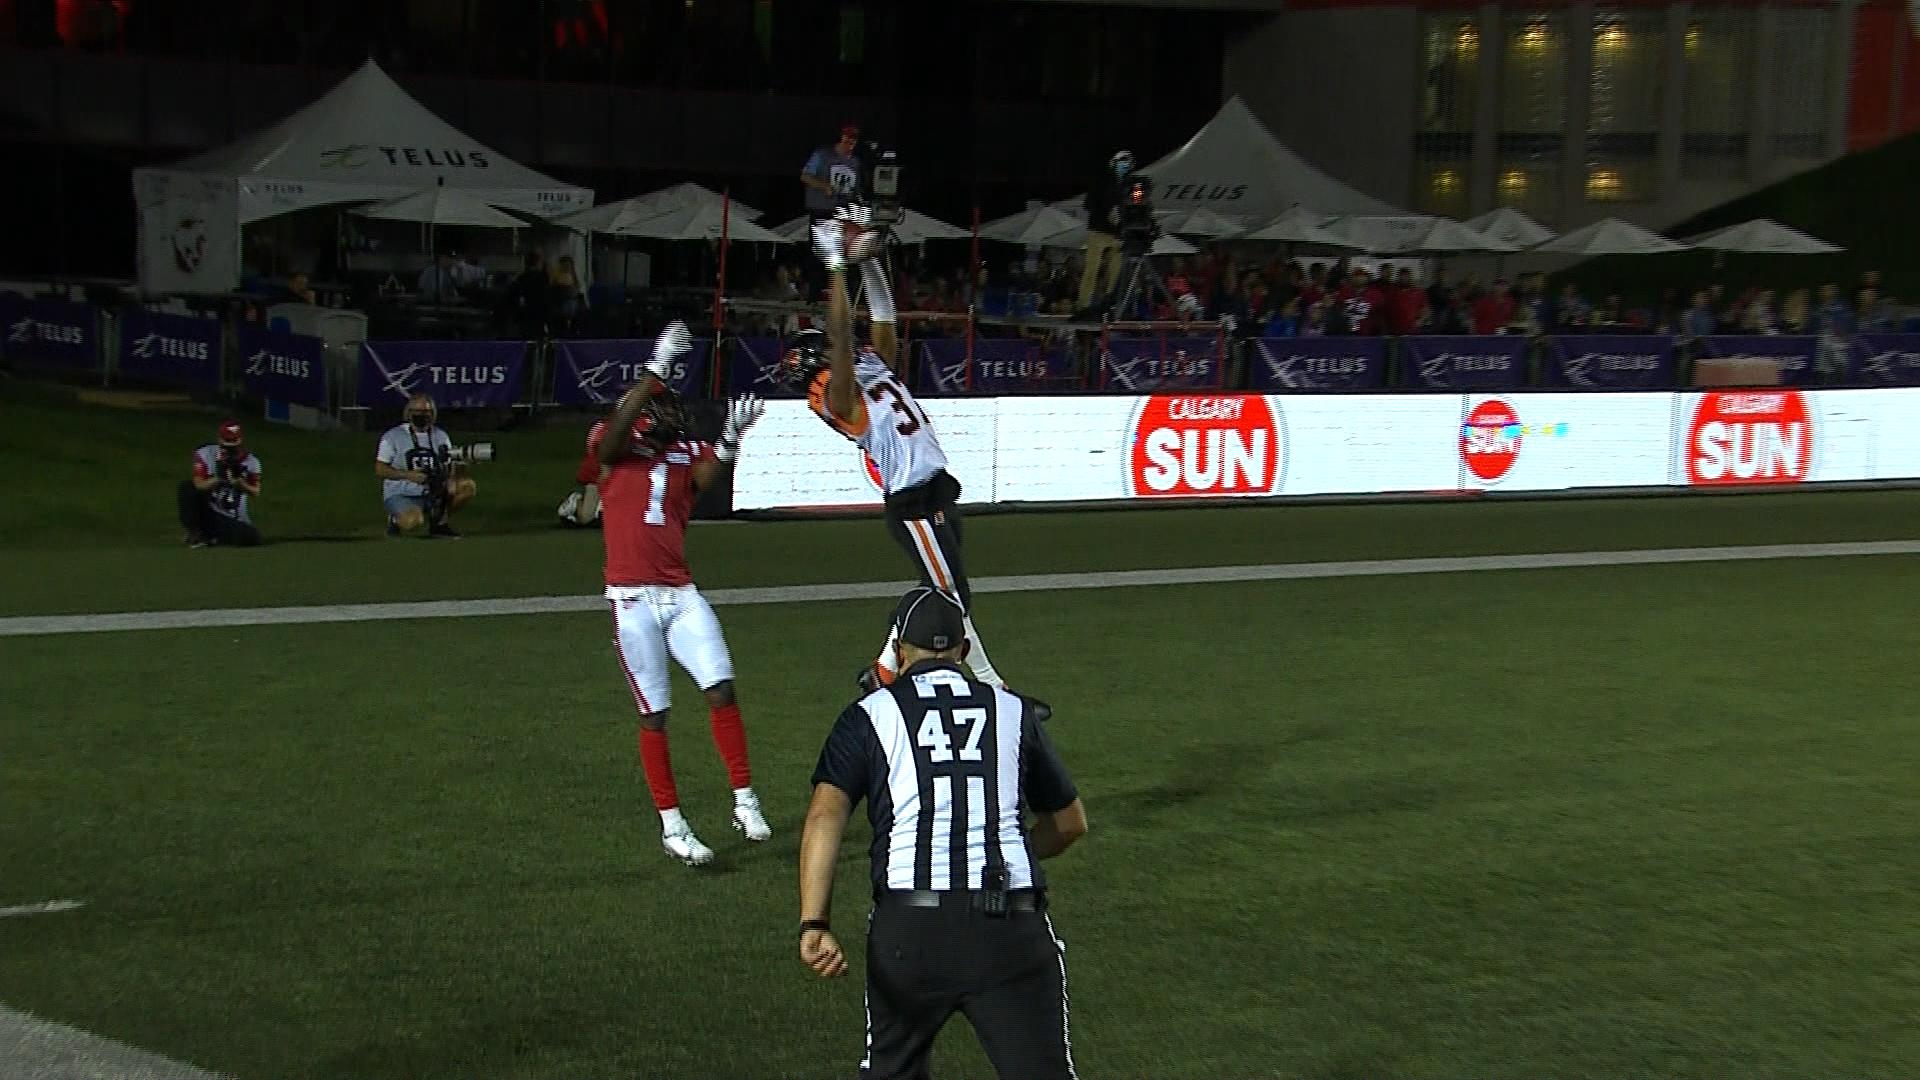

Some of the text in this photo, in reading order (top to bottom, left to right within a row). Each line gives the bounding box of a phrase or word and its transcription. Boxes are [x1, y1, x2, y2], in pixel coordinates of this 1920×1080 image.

[379, 147, 489, 168] TELUS
[1163, 185, 1249, 200] TELUS
[36, 321, 84, 344] TELUS
[160, 336, 209, 359] TELUS
[270, 353, 311, 378] TELUS
[620, 363, 686, 381] TEUS
[979, 361, 1047, 377] TELUS
[1148, 359, 1210, 375] TELUS
[1303, 357, 1368, 373] TELUS
[1453, 354, 1512, 371] TELUS
[1599, 353, 1661, 371] TELUS
[430, 366, 505, 384] TELUS
[1168, 398, 1245, 420] CALGARY
[1464, 427, 1518, 454] SUN
[1693, 420, 1804, 479] SUN
[1142, 427, 1269, 491] SUN
[643, 463, 669, 526] 1
[916, 707, 988, 763] 47
